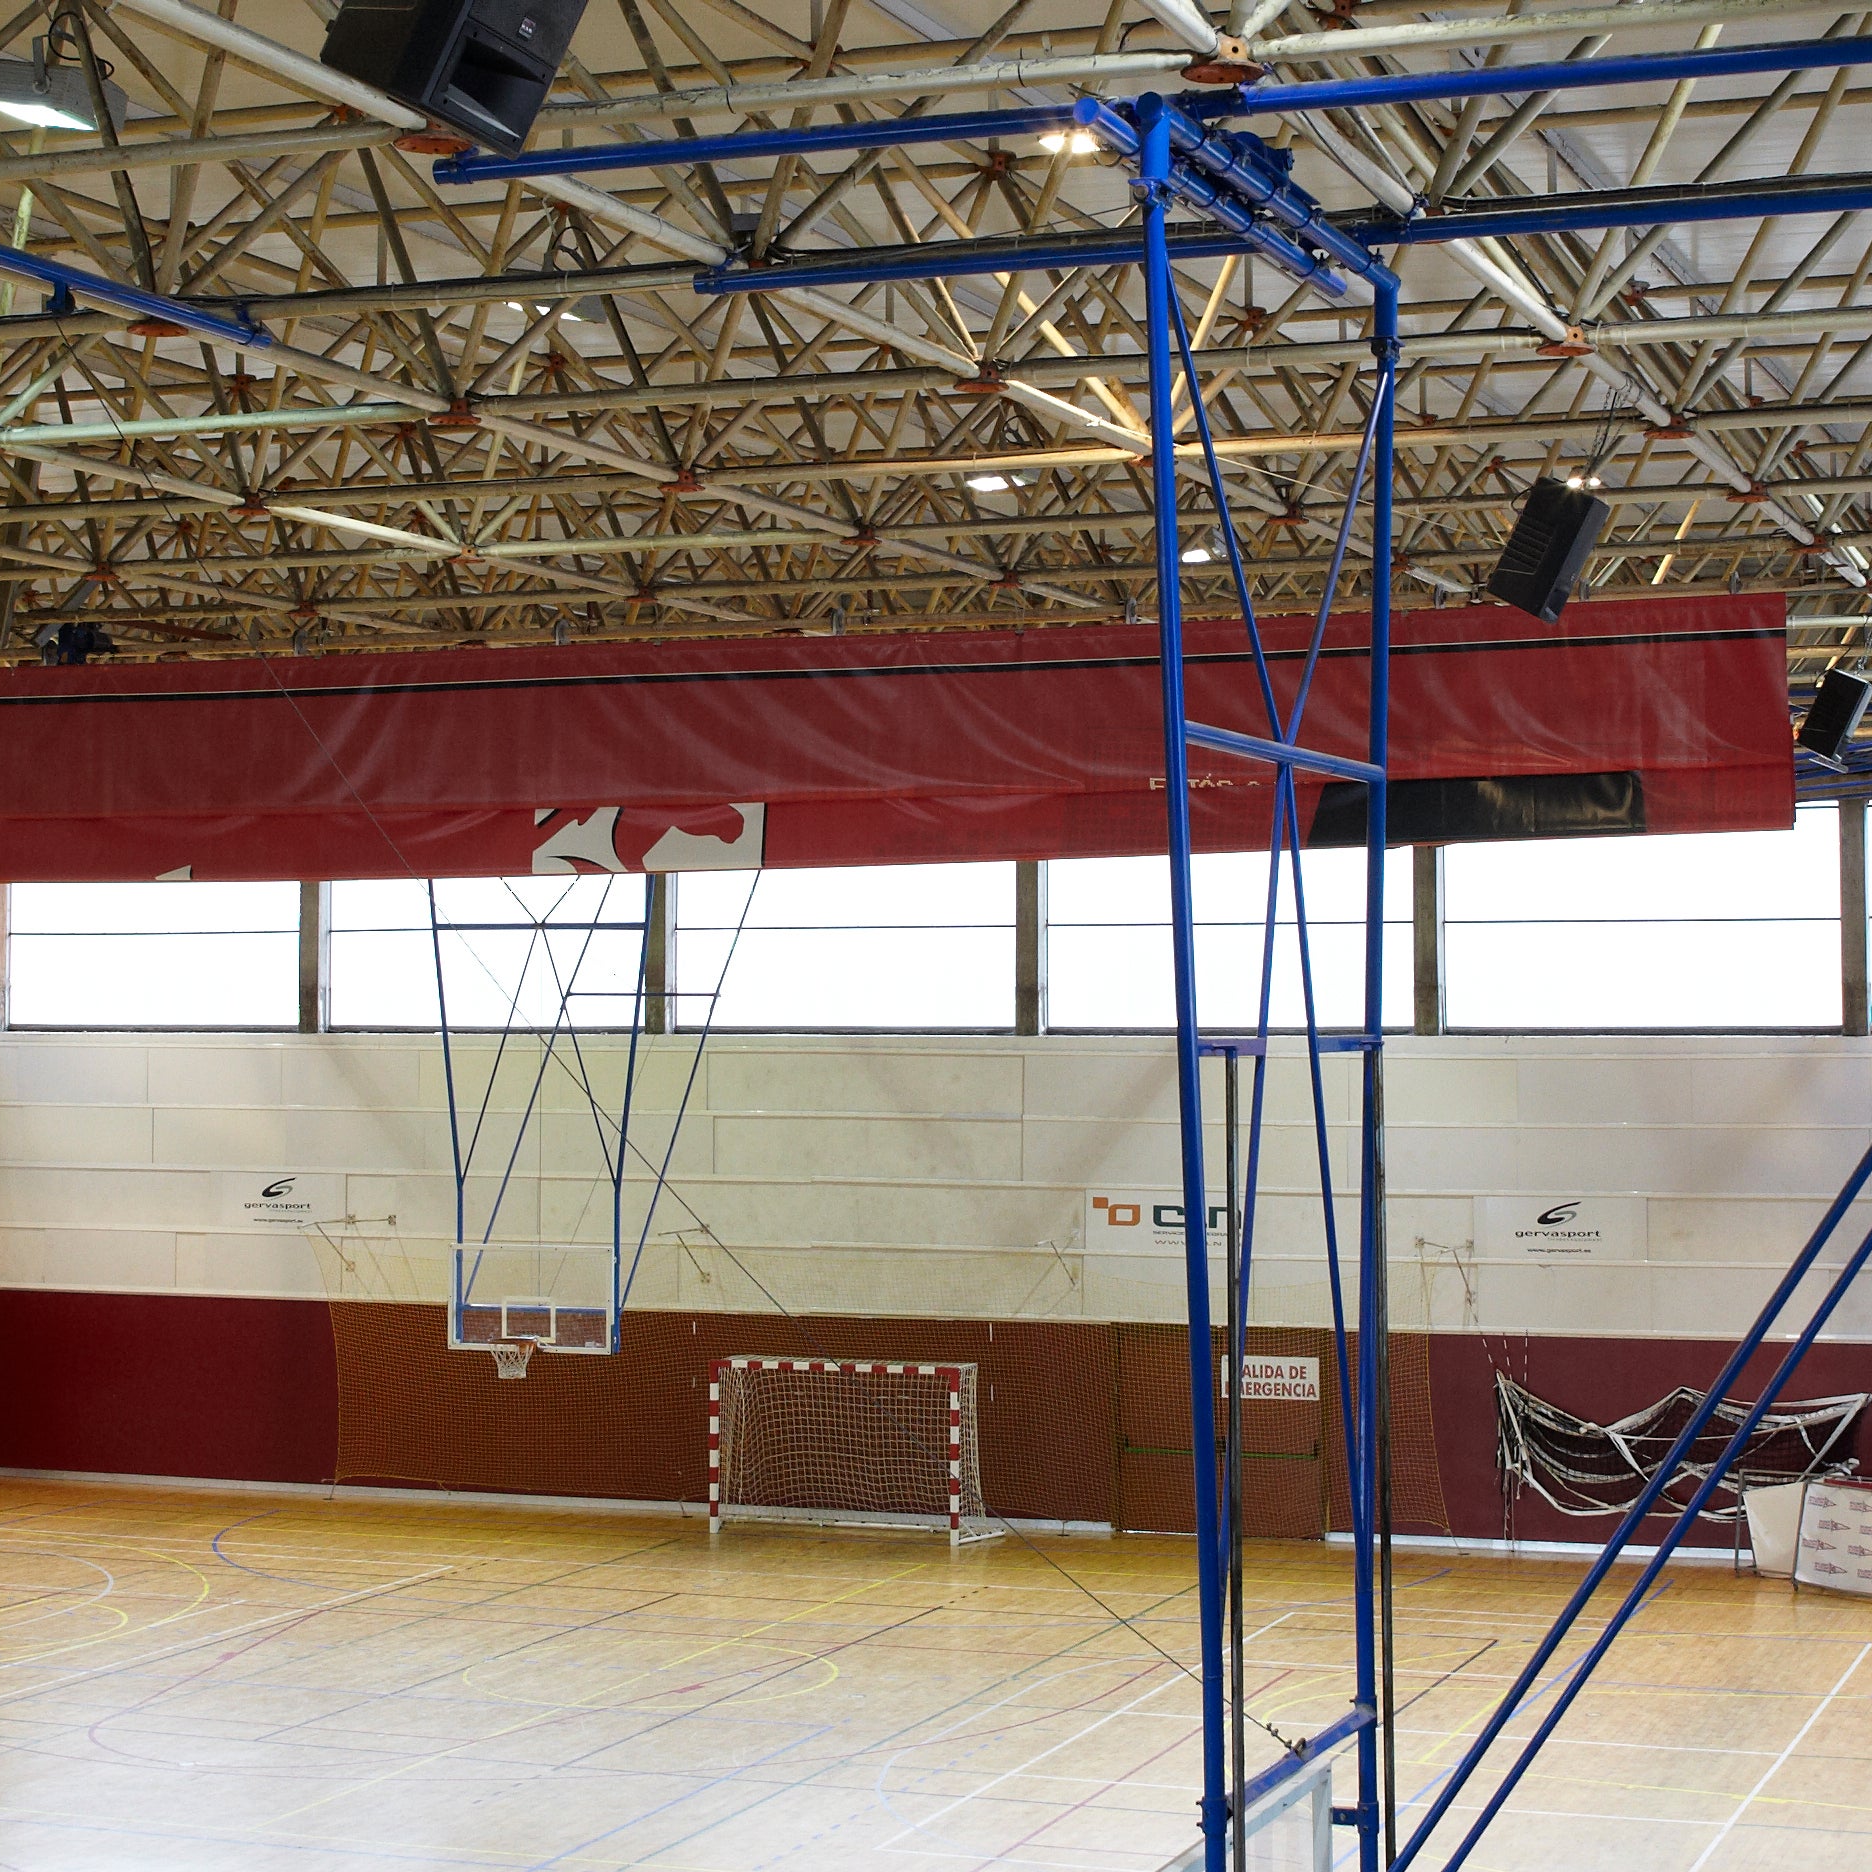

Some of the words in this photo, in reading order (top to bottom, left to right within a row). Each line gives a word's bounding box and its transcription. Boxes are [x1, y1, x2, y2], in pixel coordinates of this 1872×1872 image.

[1515, 1230, 1601, 1238] gervasport
[1242, 1364, 1285, 1379] ALIDA
[1288, 1365, 1307, 1380] DE
